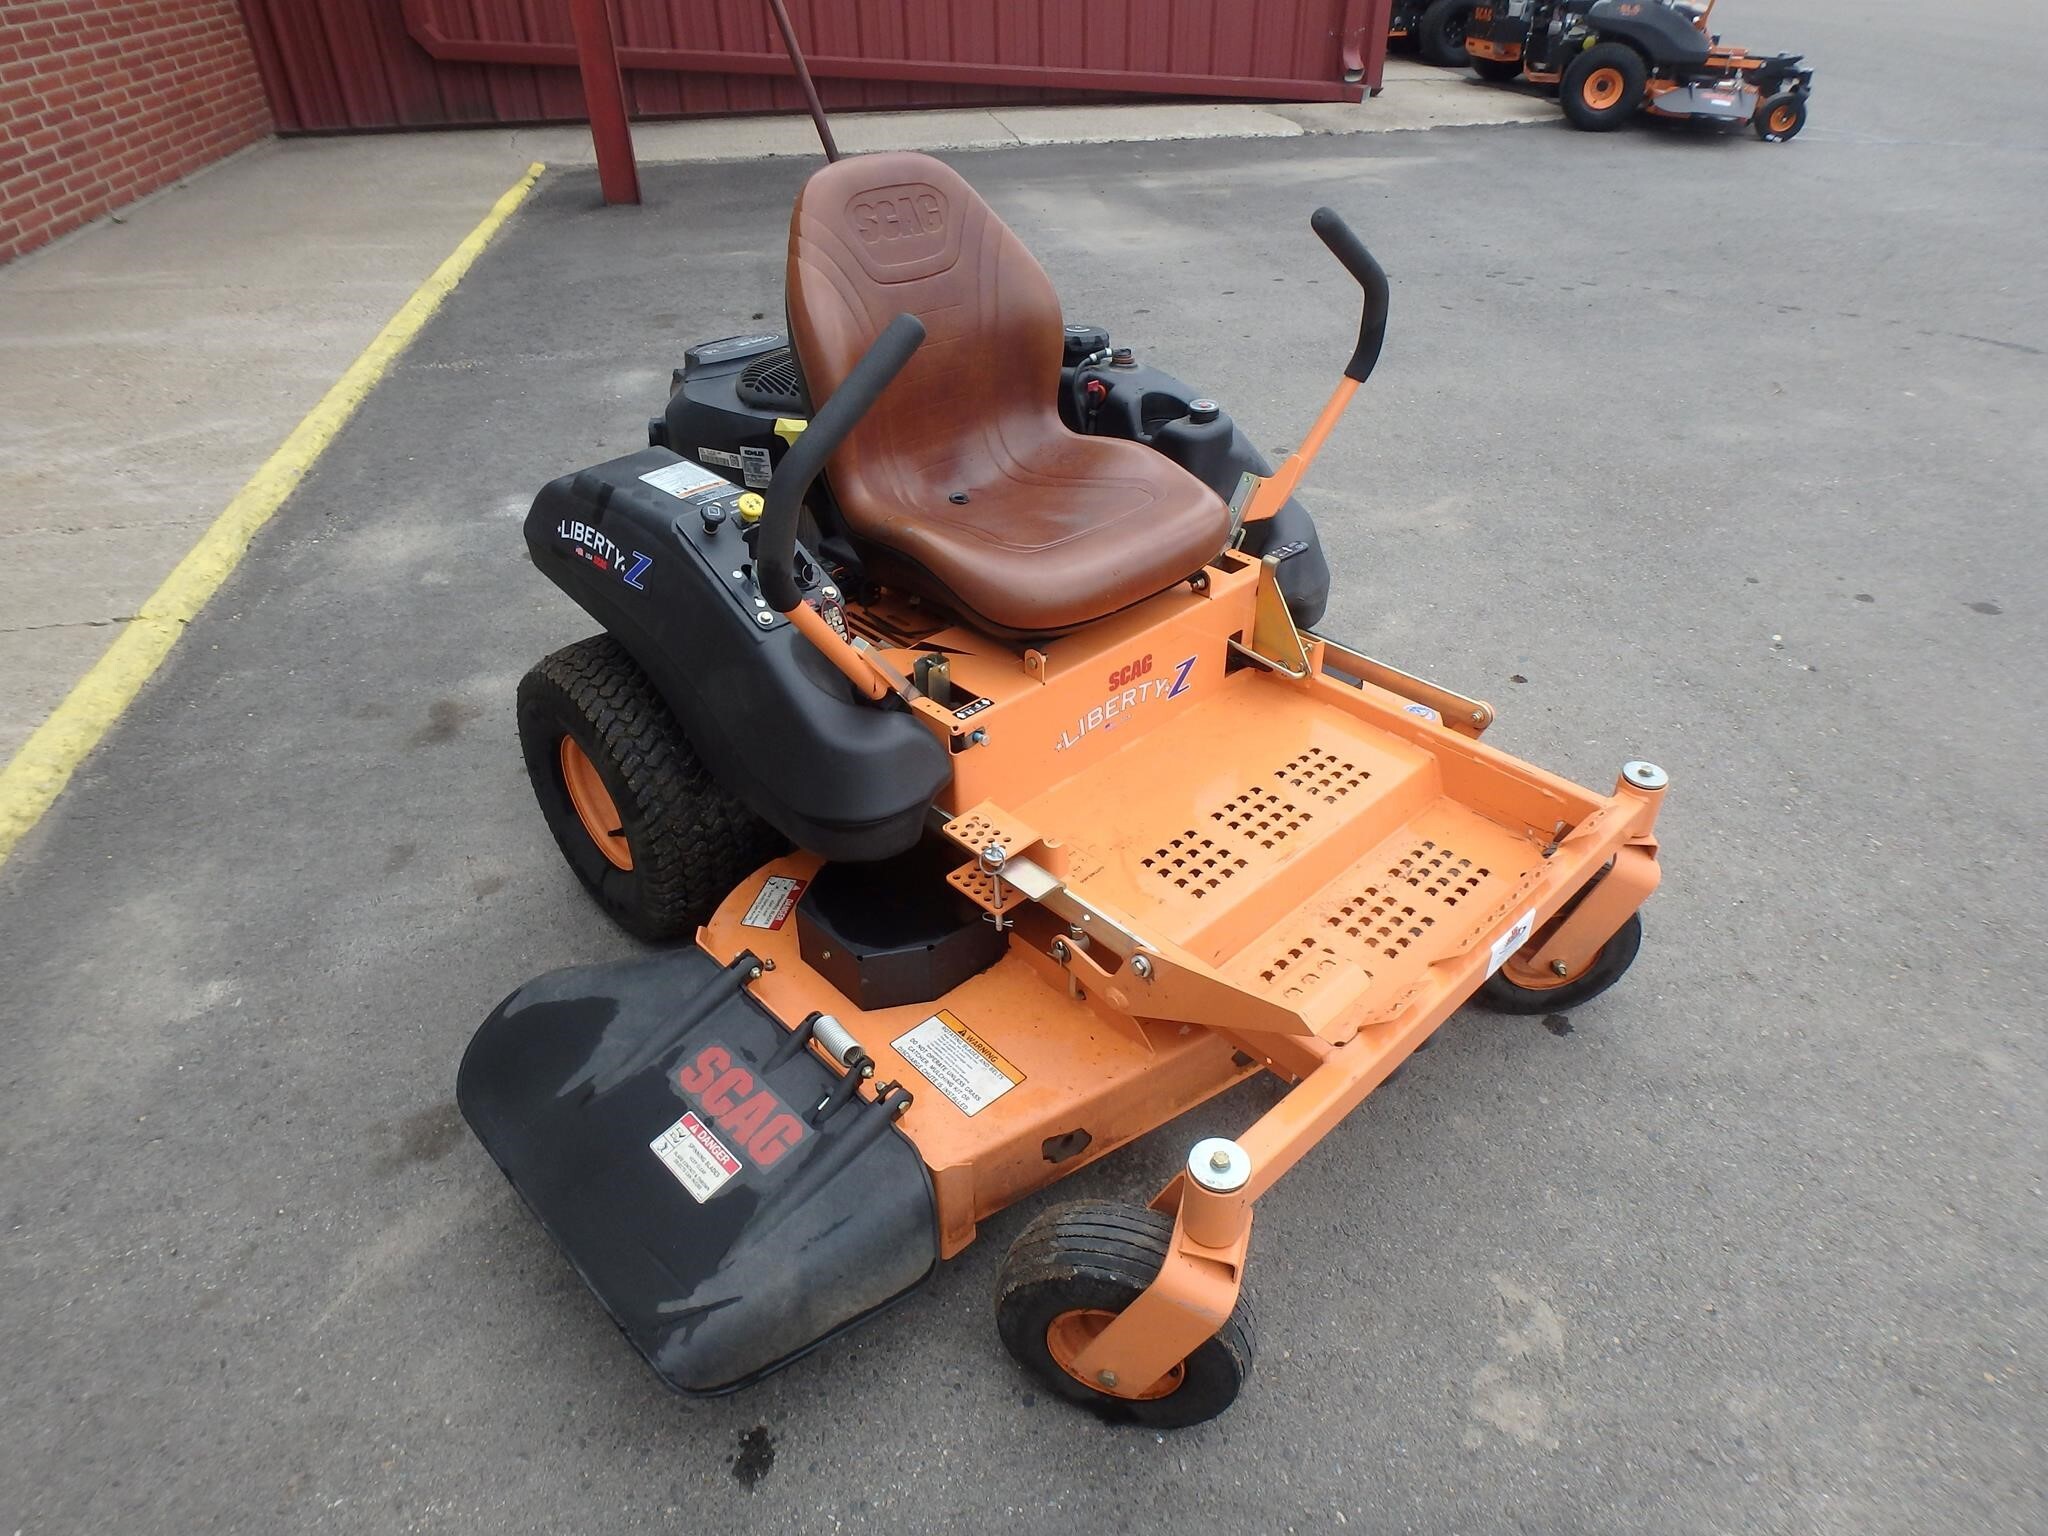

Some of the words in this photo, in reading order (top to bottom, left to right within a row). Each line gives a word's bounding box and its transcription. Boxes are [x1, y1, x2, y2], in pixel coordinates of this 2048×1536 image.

[854, 194, 943, 245] SCAG
[560, 520, 626, 570] LIBERTY
[623, 550, 653, 590] Z
[1108, 653, 1153, 692] SCAG
[1060, 678, 1169, 750] LIBERTY
[1166, 654, 1198, 701] Z
[909, 1037, 918, 1045] DO
[916, 1043, 928, 1053] NOT
[925, 1052, 947, 1071] OPERATE
[946, 1070, 966, 1087] UNLESS
[963, 1086, 981, 1101] GRASS
[940, 1026, 963, 1044] ROTATING
[961, 1043, 980, 1059] BLADES
[978, 1058, 990, 1067] AND
[988, 1066, 1004, 1079] BELTS
[964, 1034, 999, 1062] WARNING
[896, 1046, 922, 1068] DISCHARGE
[921, 1068, 938, 1082] CHUTE
[941, 1086, 968, 1110] INSTALLED
[928, 1064, 954, 1087] MULCHING
[952, 1085, 962, 1094] KIT
[960, 1093, 970, 1101] OR
[680, 1046, 804, 1166] SCAG
[696, 1129, 730, 1165] DANGER
